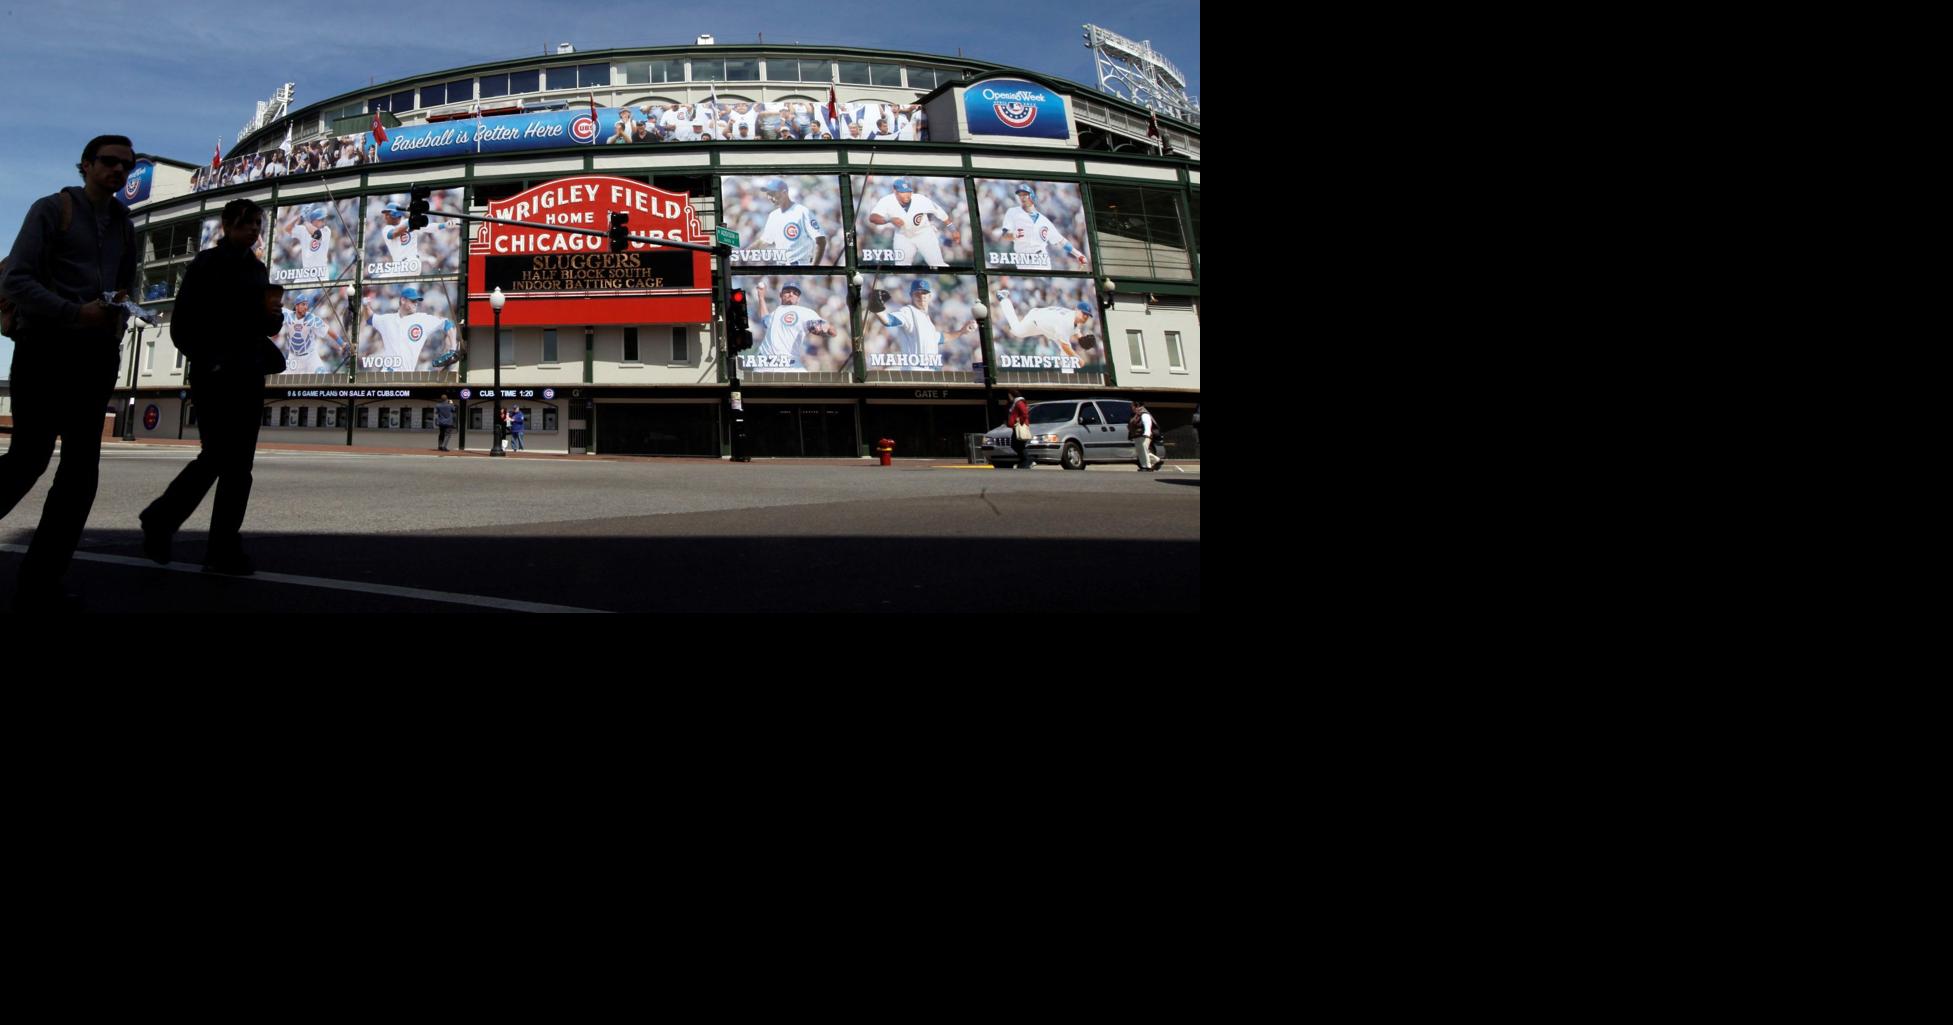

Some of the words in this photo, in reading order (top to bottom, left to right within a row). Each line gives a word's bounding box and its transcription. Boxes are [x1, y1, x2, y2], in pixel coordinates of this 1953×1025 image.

[982, 88, 1021, 101] Opening
[1018, 90, 1046, 102] Week
[391, 128, 455, 152] Baseball
[456, 130, 470, 144] is
[473, 124, 520, 142] Better
[524, 121, 564, 139] Here
[495, 183, 600, 226] WRIGLEY
[611, 185, 681, 220] FIELD
[546, 211, 595, 225] HOME
[495, 232, 602, 253] CHICAGO
[630, 229, 683, 249] UBS
[532, 252, 641, 271] SLUGGERS
[730, 249, 787, 262] SVEUM
[862, 249, 905, 262] BYRD
[989, 252, 1051, 266] BARNEY
[274, 266, 328, 281] JOHNSON
[367, 260, 420, 274] CASTRO
[522, 269, 558, 281] HALF
[560, 268, 605, 280] BLOCK
[608, 267, 652, 279] SOUTH
[512, 280, 561, 290] INDOOR
[565, 278, 622, 290] BATTING
[625, 277, 664, 289] CAGE
[361, 355, 403, 369] WOOD
[871, 353, 943, 367] MAHOLM
[1001, 355, 1081, 368] DEMPSTER
[914, 390, 939, 398] GATE
[942, 390, 949, 398] F
